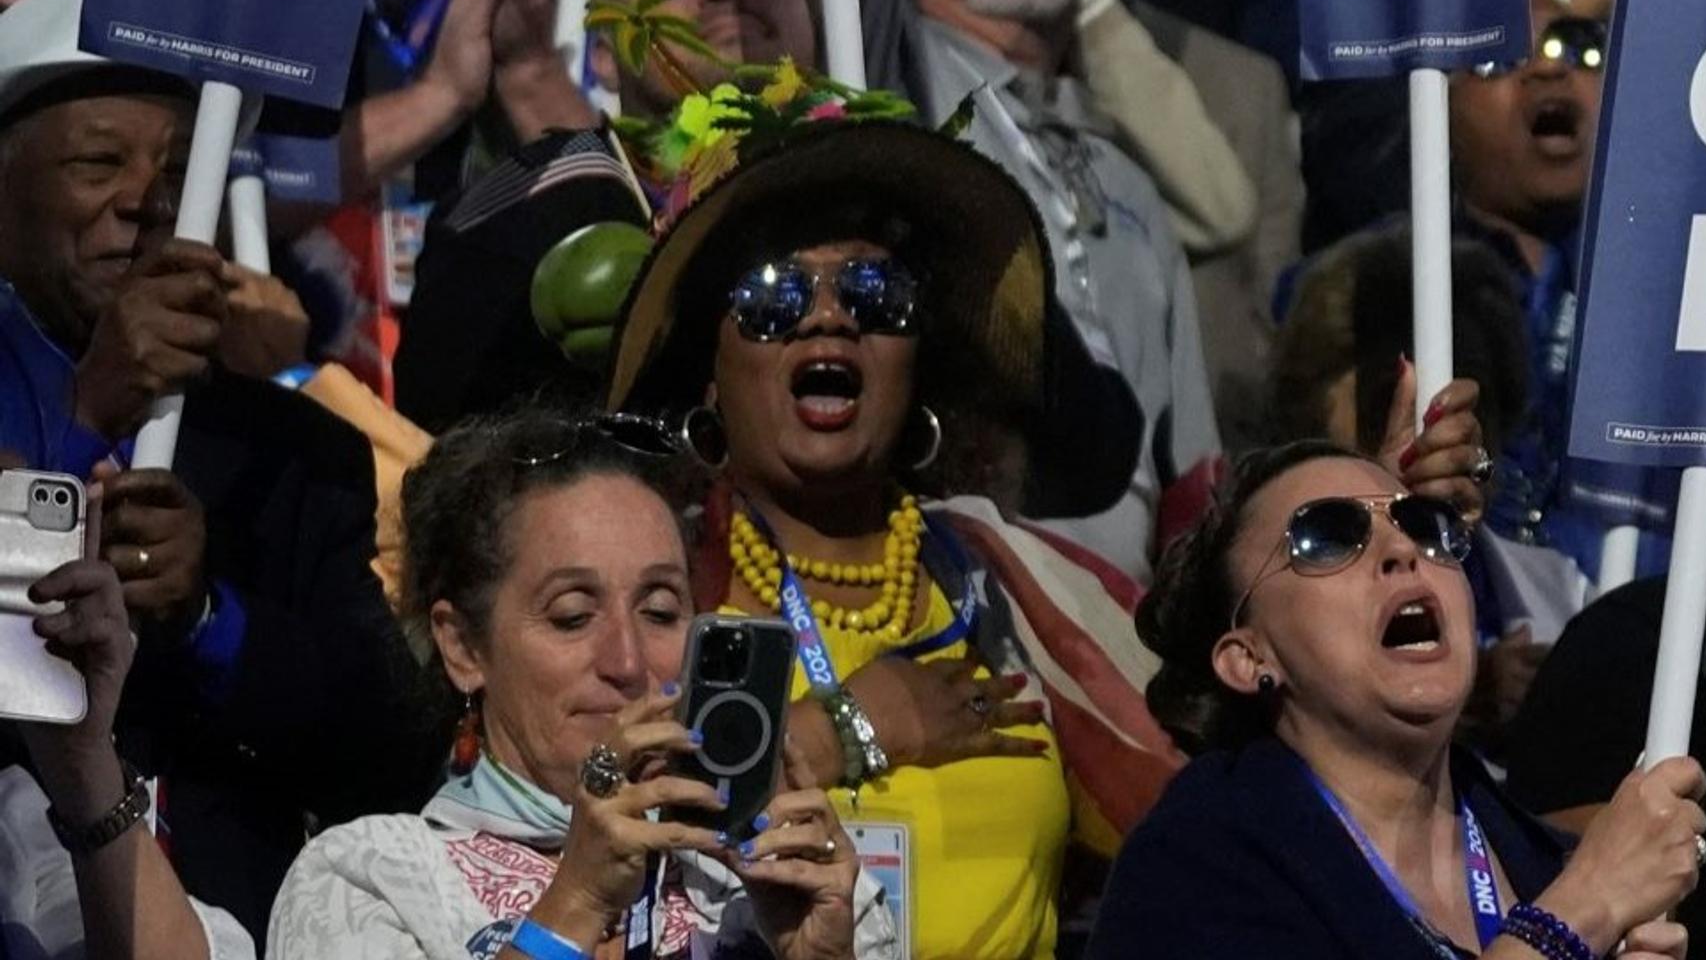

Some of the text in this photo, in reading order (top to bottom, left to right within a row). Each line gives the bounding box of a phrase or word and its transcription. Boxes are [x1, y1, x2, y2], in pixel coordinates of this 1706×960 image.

[115, 26, 146, 41] PAID
[172, 39, 213, 58] HARRIS
[214, 48, 240, 62] FOR
[241, 54, 310, 78] PRESIDENT
[1334, 45, 1363, 57] PAID
[1419, 36, 1445, 48] FOR
[1614, 427, 1646, 441] PAID
[782, 583, 811, 632] DNC
[1472, 869, 1497, 915] DNC
